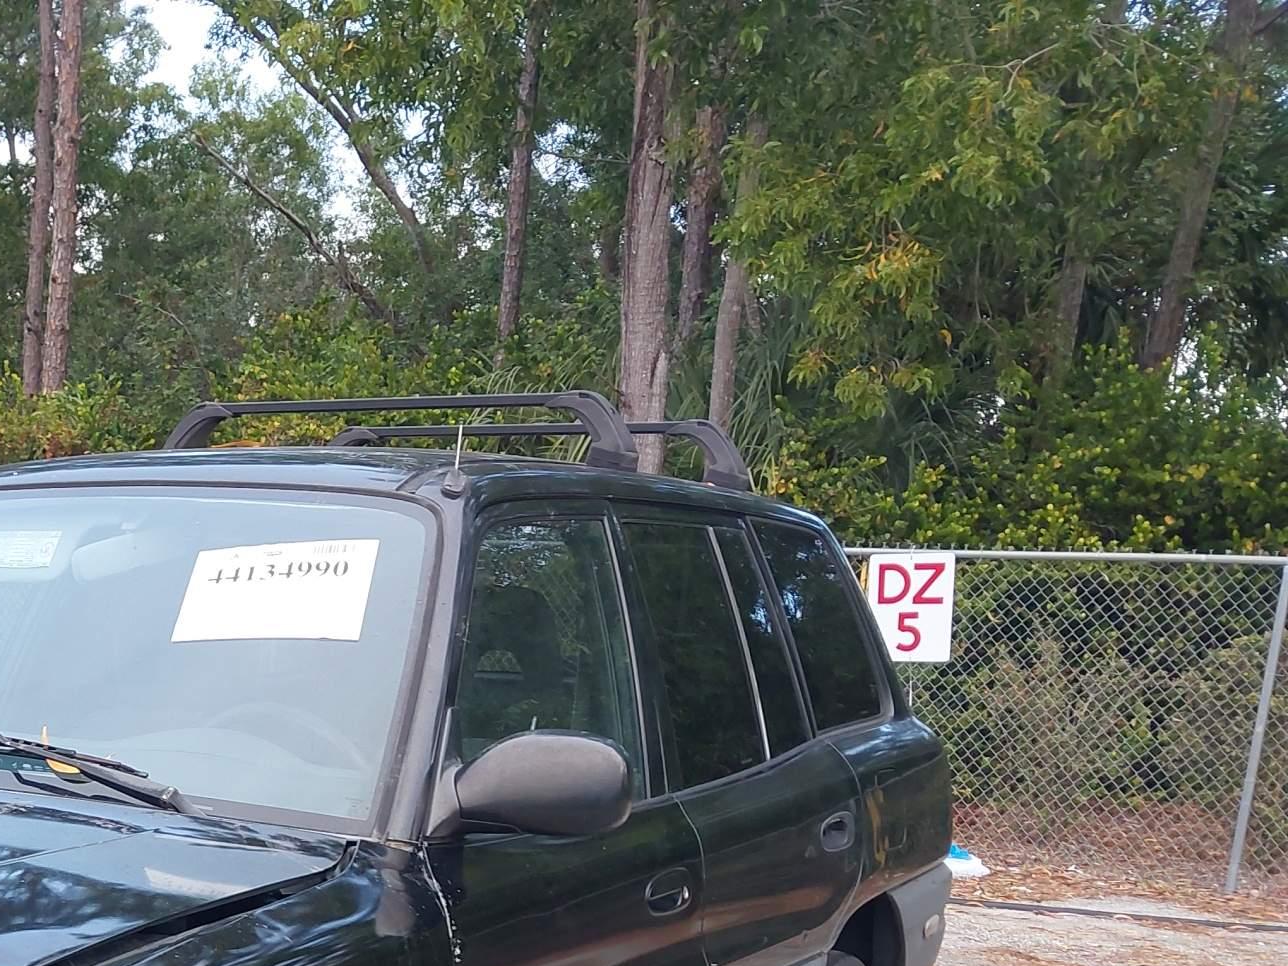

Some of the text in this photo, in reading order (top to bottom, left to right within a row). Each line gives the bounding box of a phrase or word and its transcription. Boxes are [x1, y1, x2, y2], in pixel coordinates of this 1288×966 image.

[208, 561, 349, 583] 44134990
[877, 563, 946, 604] DZ
[896, 612, 921, 652] 5
